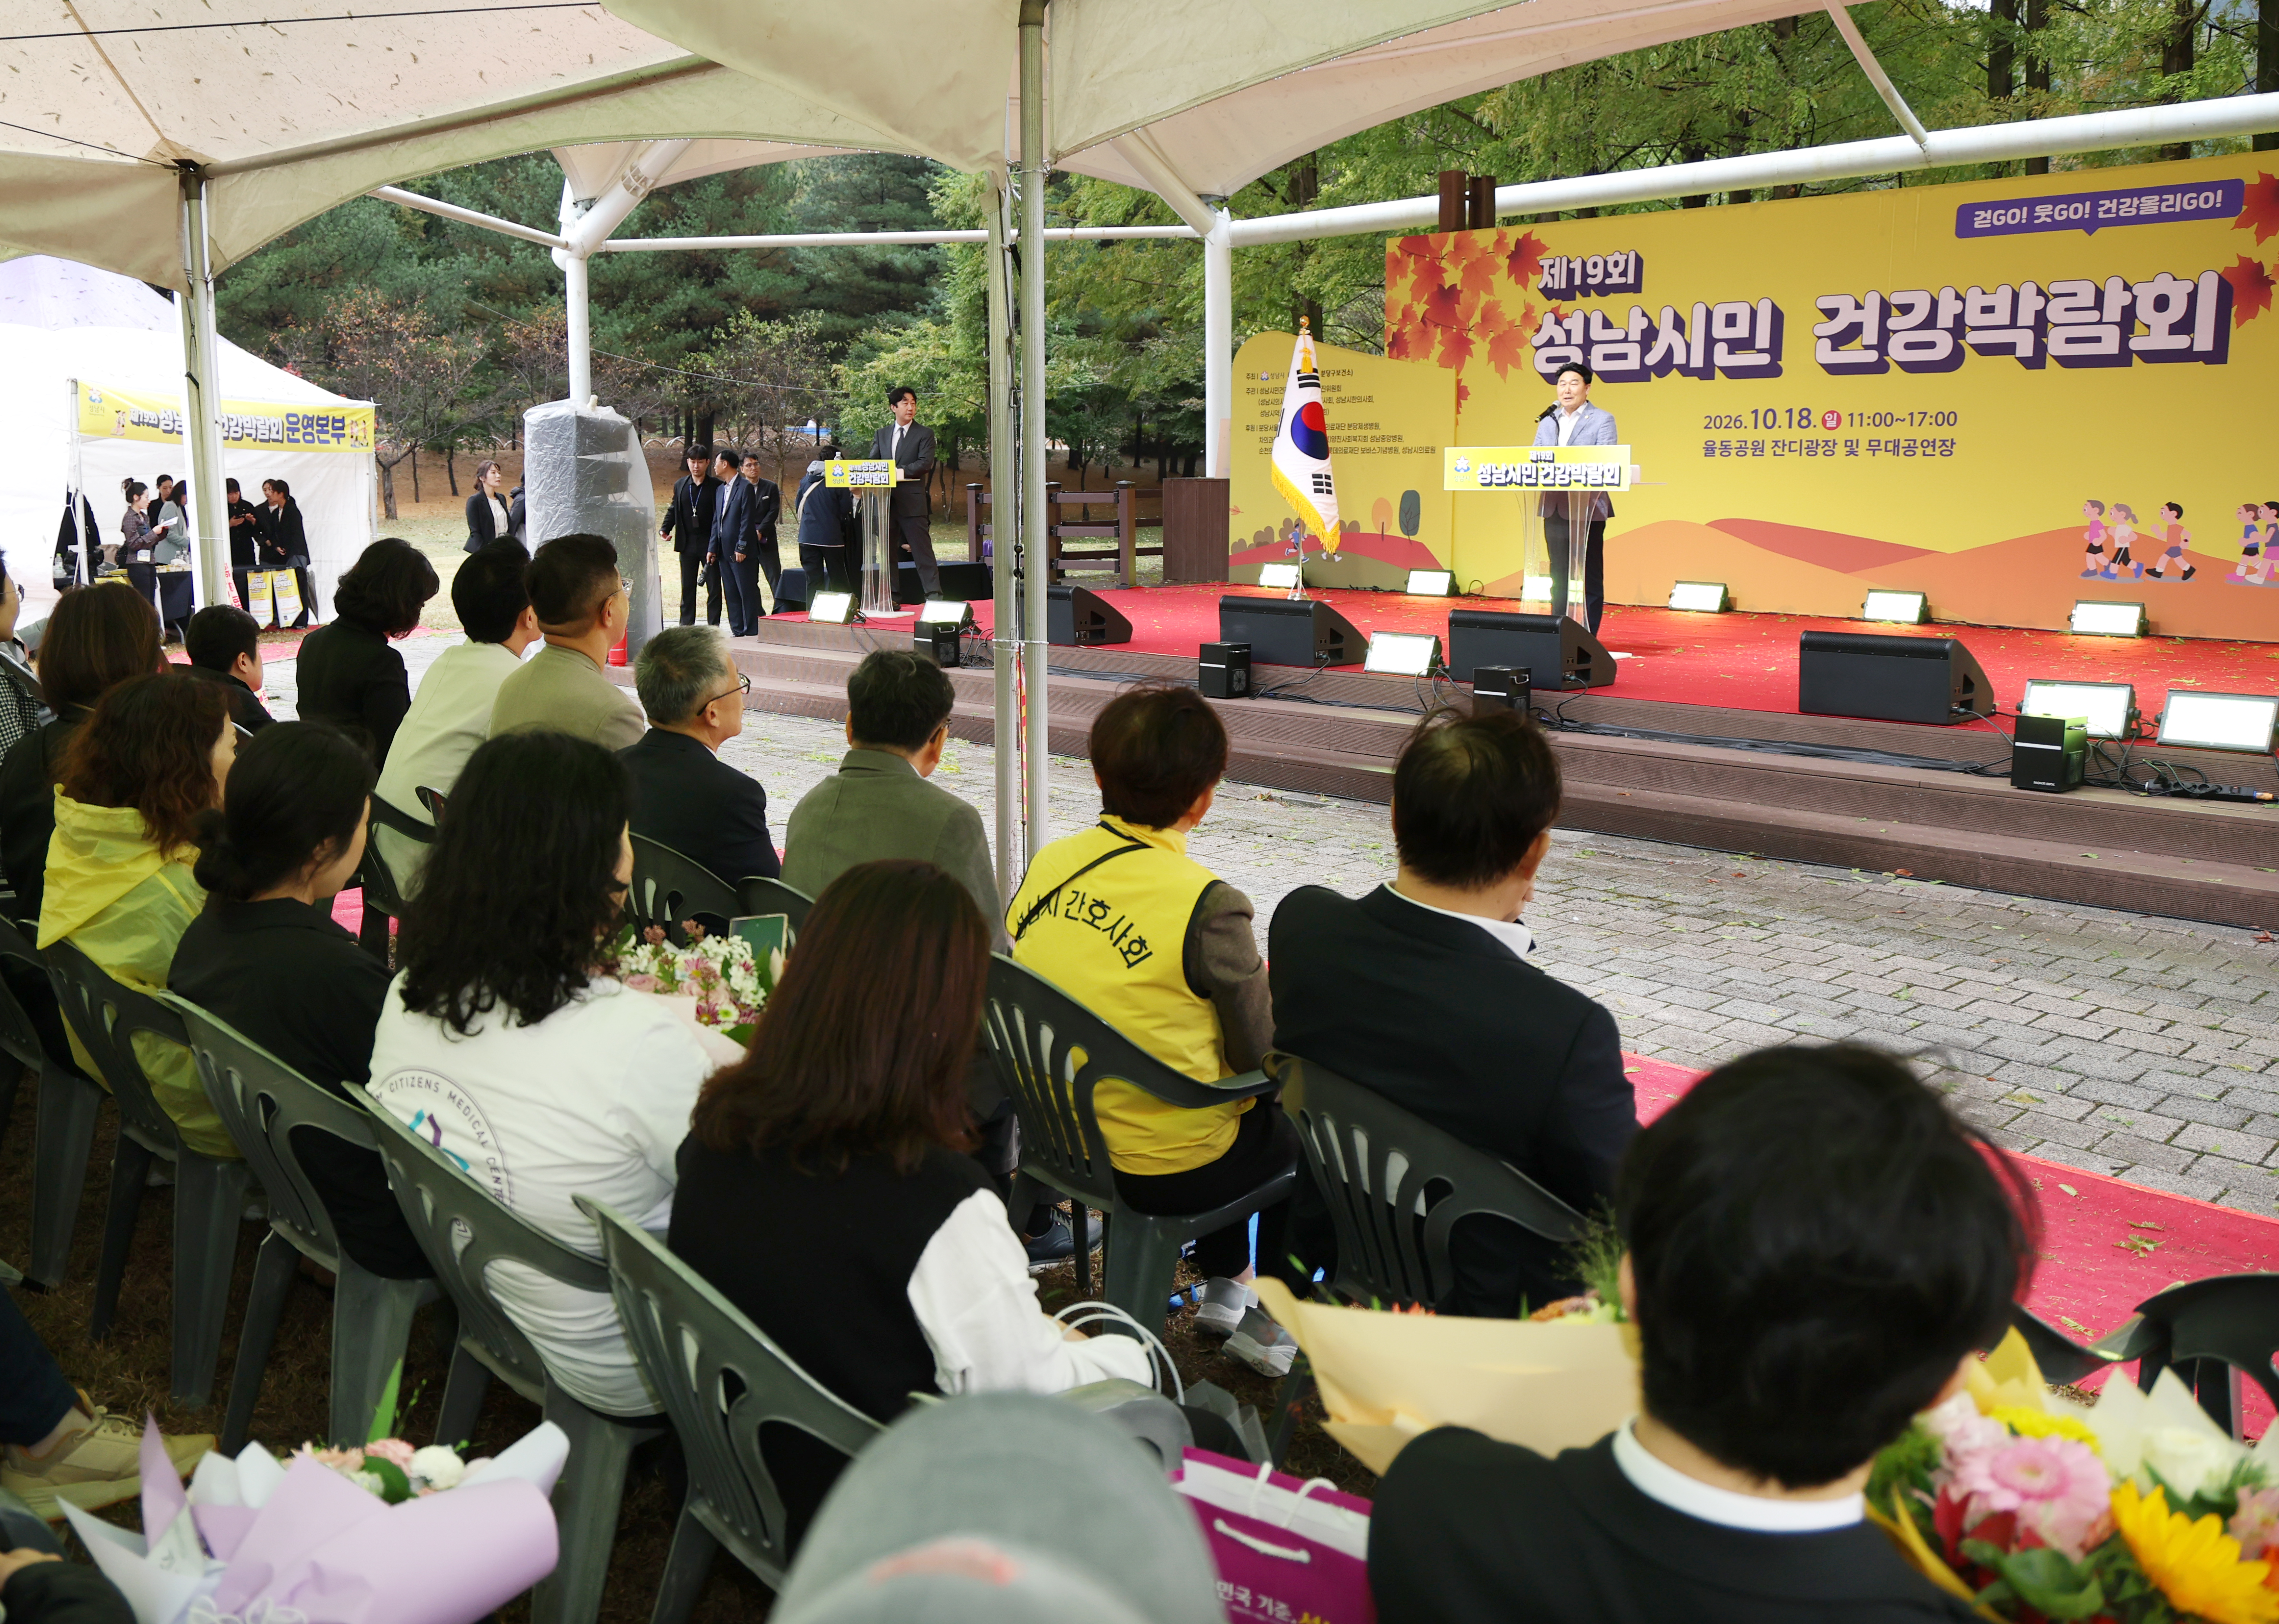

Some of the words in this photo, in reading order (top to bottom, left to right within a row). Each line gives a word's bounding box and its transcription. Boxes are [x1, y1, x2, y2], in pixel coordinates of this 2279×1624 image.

[1973, 206, 2028, 229] 걷GO!
[2034, 201, 2091, 224] 웃GO!
[2098, 189, 2223, 218] 건강올리GO!
[1537, 249, 1643, 301] 제19회
[1530, 297, 1784, 385] 성남시민
[1812, 270, 2233, 375] 건강박람회
[88, 405, 105, 413] 성남시
[1703, 407, 1817, 430] 2026.10.18.
[1824, 412, 1838, 428] 일
[1848, 411, 1958, 428] 11:00~17:00
[129, 408, 160, 428] 제19회
[159, 408, 183, 435] 성남
[286, 412, 346, 445] 운영본부
[1402, 446, 1436, 454] 성남시의료원
[1528, 450, 1554, 463] 제19회
[1703, 439, 1765, 457] 율동공원
[1771, 438, 1838, 457] 잔디광장
[1844, 438, 1859, 457] 및
[1866, 438, 1956, 457] 무대공연장
[848, 473, 889, 485] 건강박람회
[862, 462, 889, 473] 성남시민
[1476, 462, 1539, 487] 성남시민
[1539, 462, 1621, 487] 건강박람회
[1064, 890, 1153, 969] 간호사회
[389, 1076, 439, 1093] CITIZENS
[447, 1090, 488, 1149] MEDICAL
